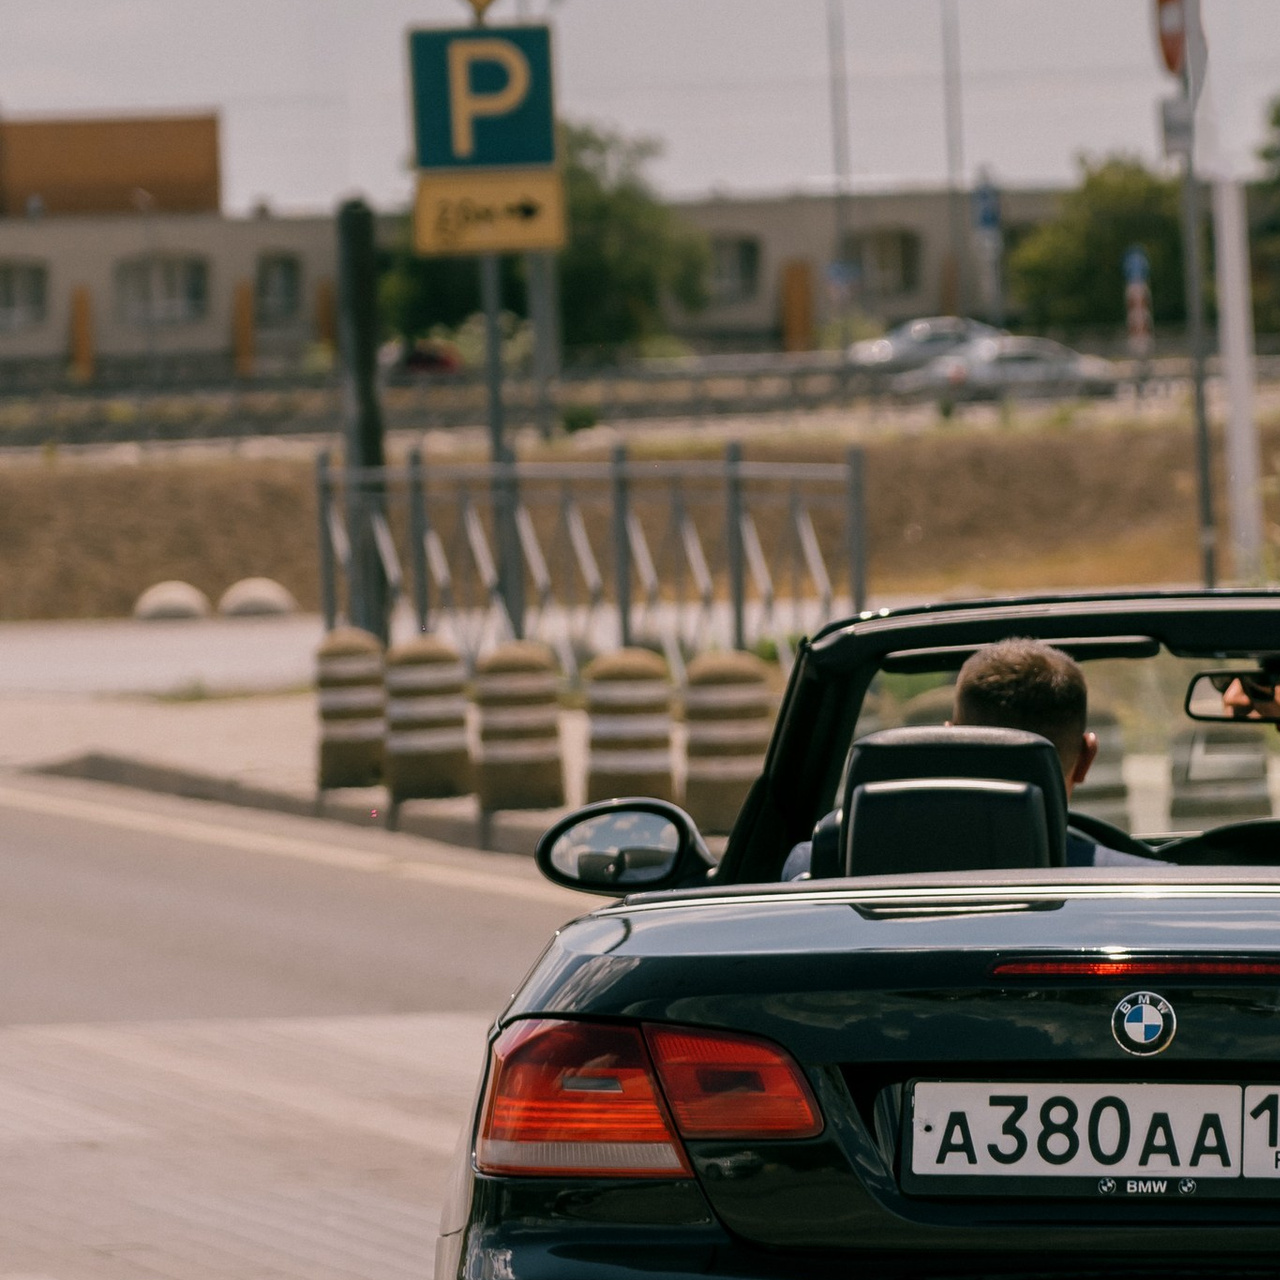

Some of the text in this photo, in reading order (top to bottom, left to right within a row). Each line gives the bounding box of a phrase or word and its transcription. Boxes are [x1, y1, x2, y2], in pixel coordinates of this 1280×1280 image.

[448, 39, 531, 157] P
[1119, 994, 1171, 1014] BMW
[1126, 1180, 1168, 1193] BMW
